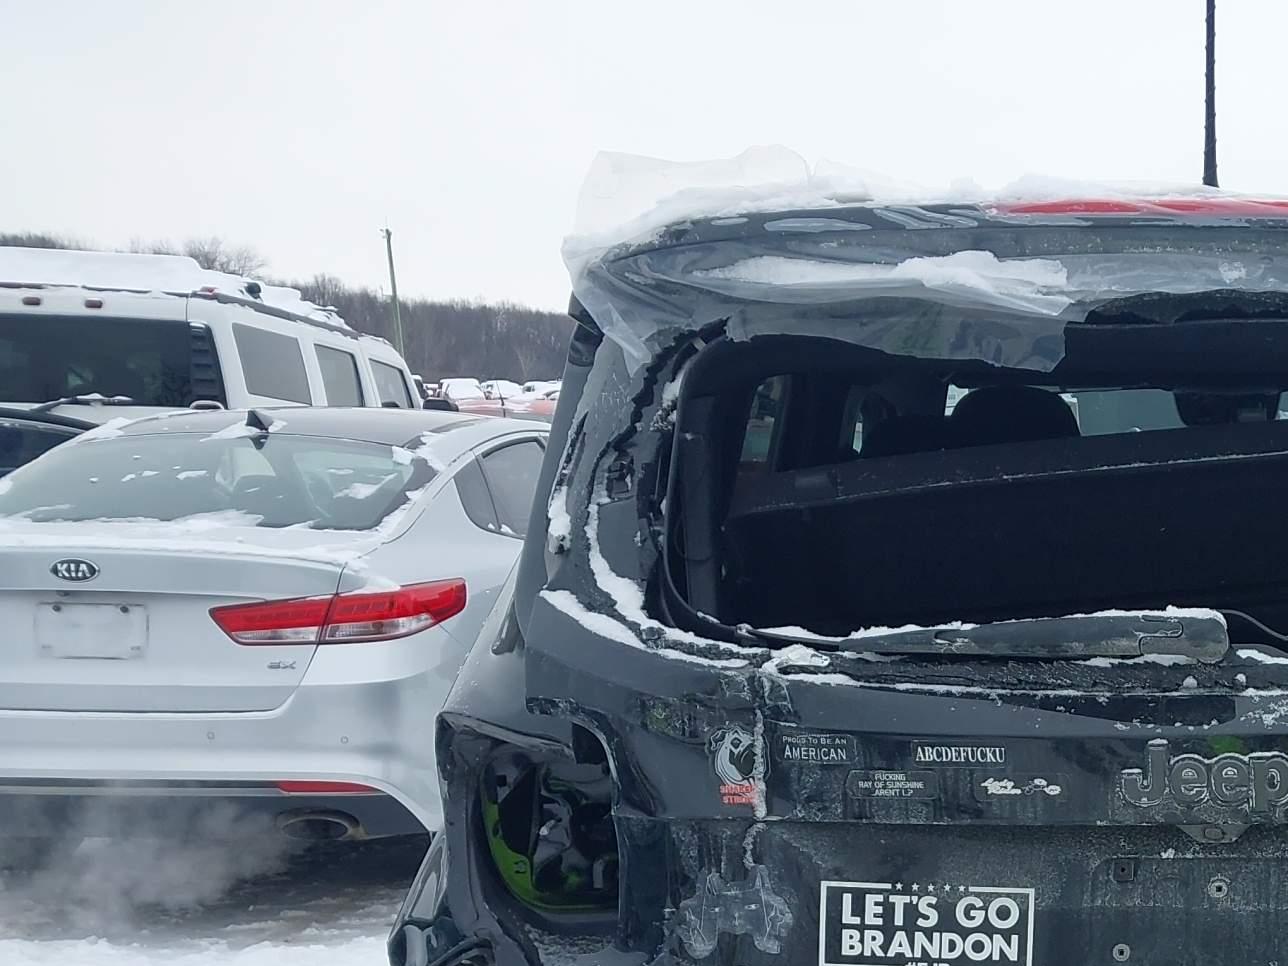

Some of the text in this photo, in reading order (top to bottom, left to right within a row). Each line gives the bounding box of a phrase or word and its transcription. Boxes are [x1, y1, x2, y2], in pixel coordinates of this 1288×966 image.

[56, 562, 92, 579] KIA
[267, 660, 297, 670] EX
[783, 744, 847, 760] AMERICAN
[915, 746, 1005, 763] ABCDEFUCKU
[858, 781, 874, 789] RAY
[886, 781, 925, 789] SUNSHINE
[874, 773, 906, 781] FUCKING
[842, 892, 1020, 929] LET'S GO
[841, 929, 1019, 962] BRANDON
